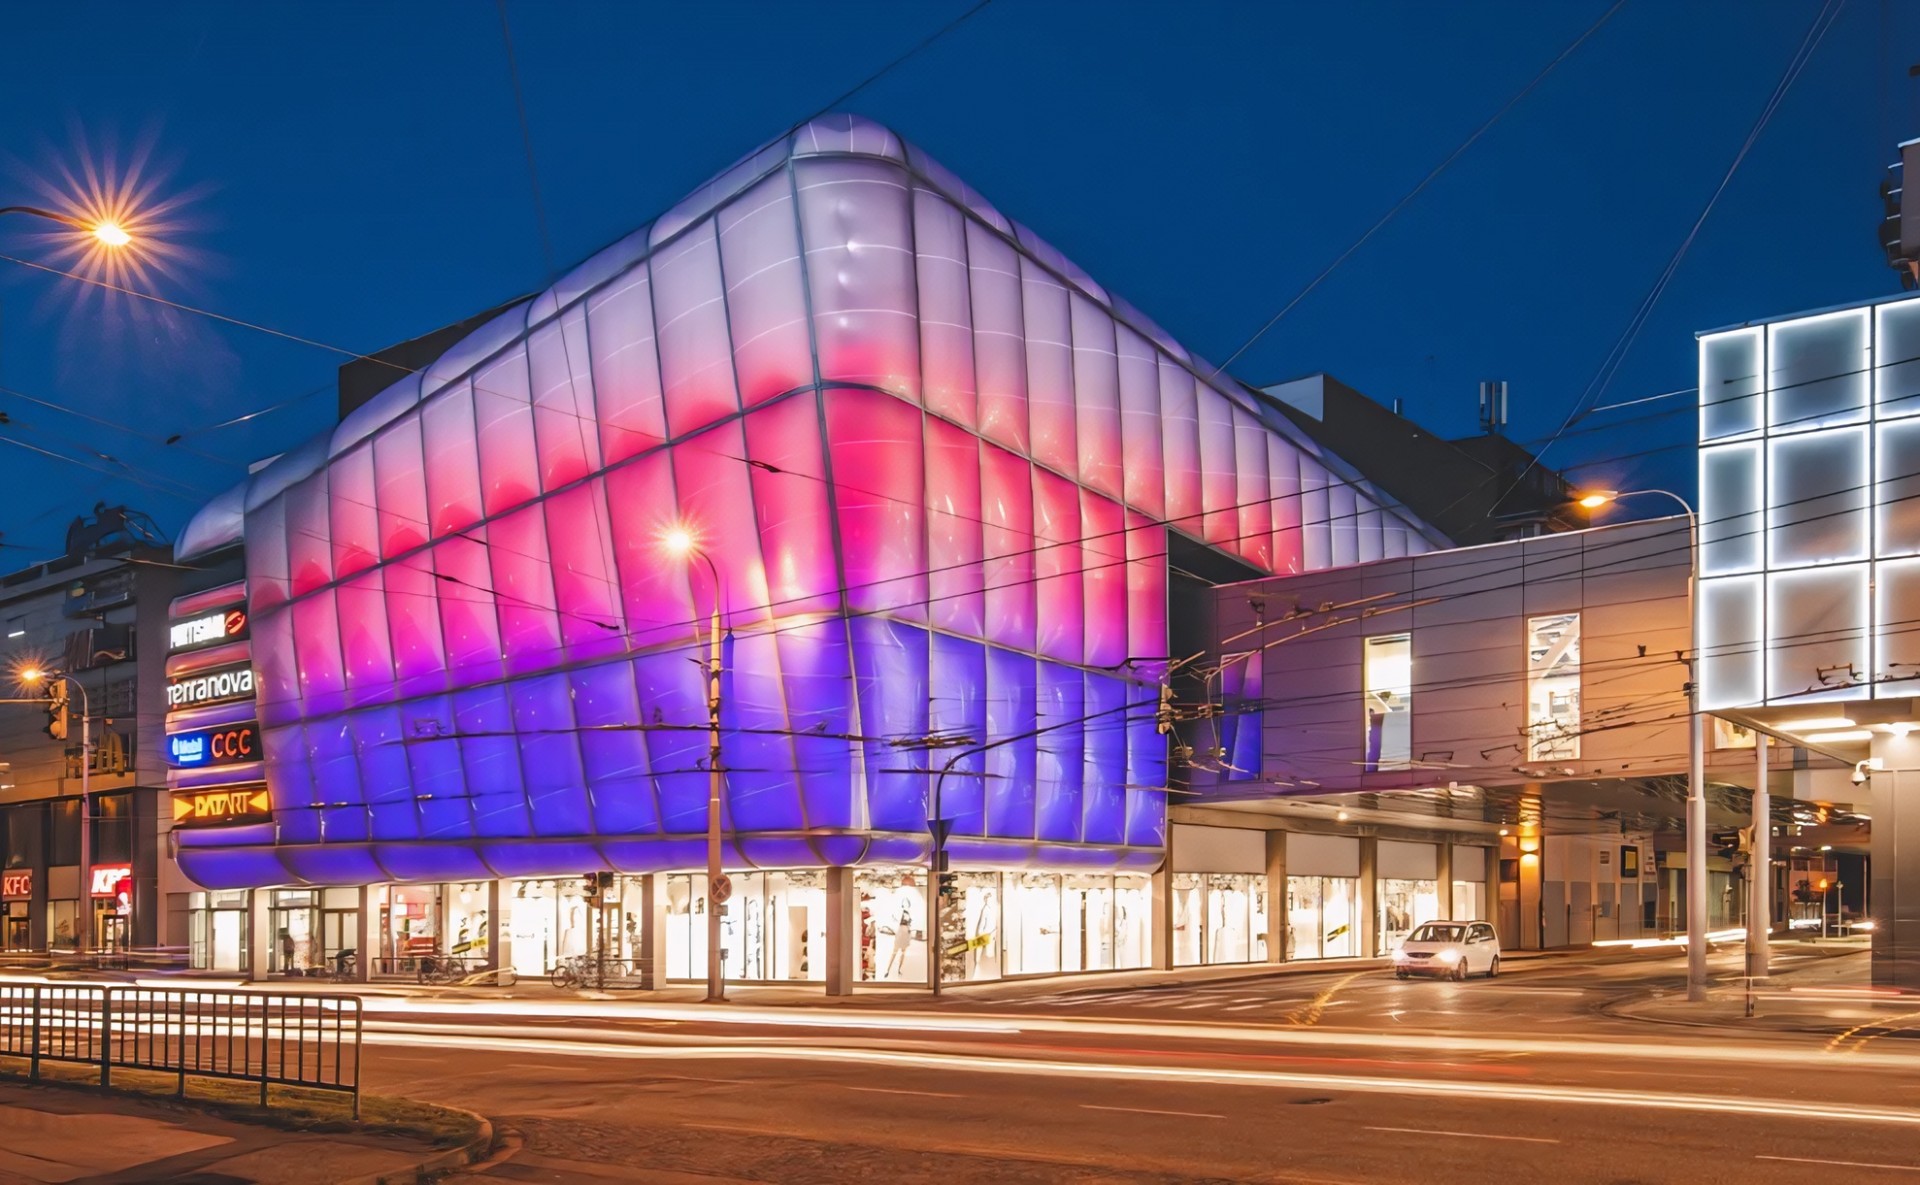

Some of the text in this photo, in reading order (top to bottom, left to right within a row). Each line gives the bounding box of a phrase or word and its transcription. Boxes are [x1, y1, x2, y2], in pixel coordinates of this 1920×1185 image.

[211, 729, 251, 758] CCC
[194, 791, 253, 817] DATART
[3, 876, 30, 896] KFC
